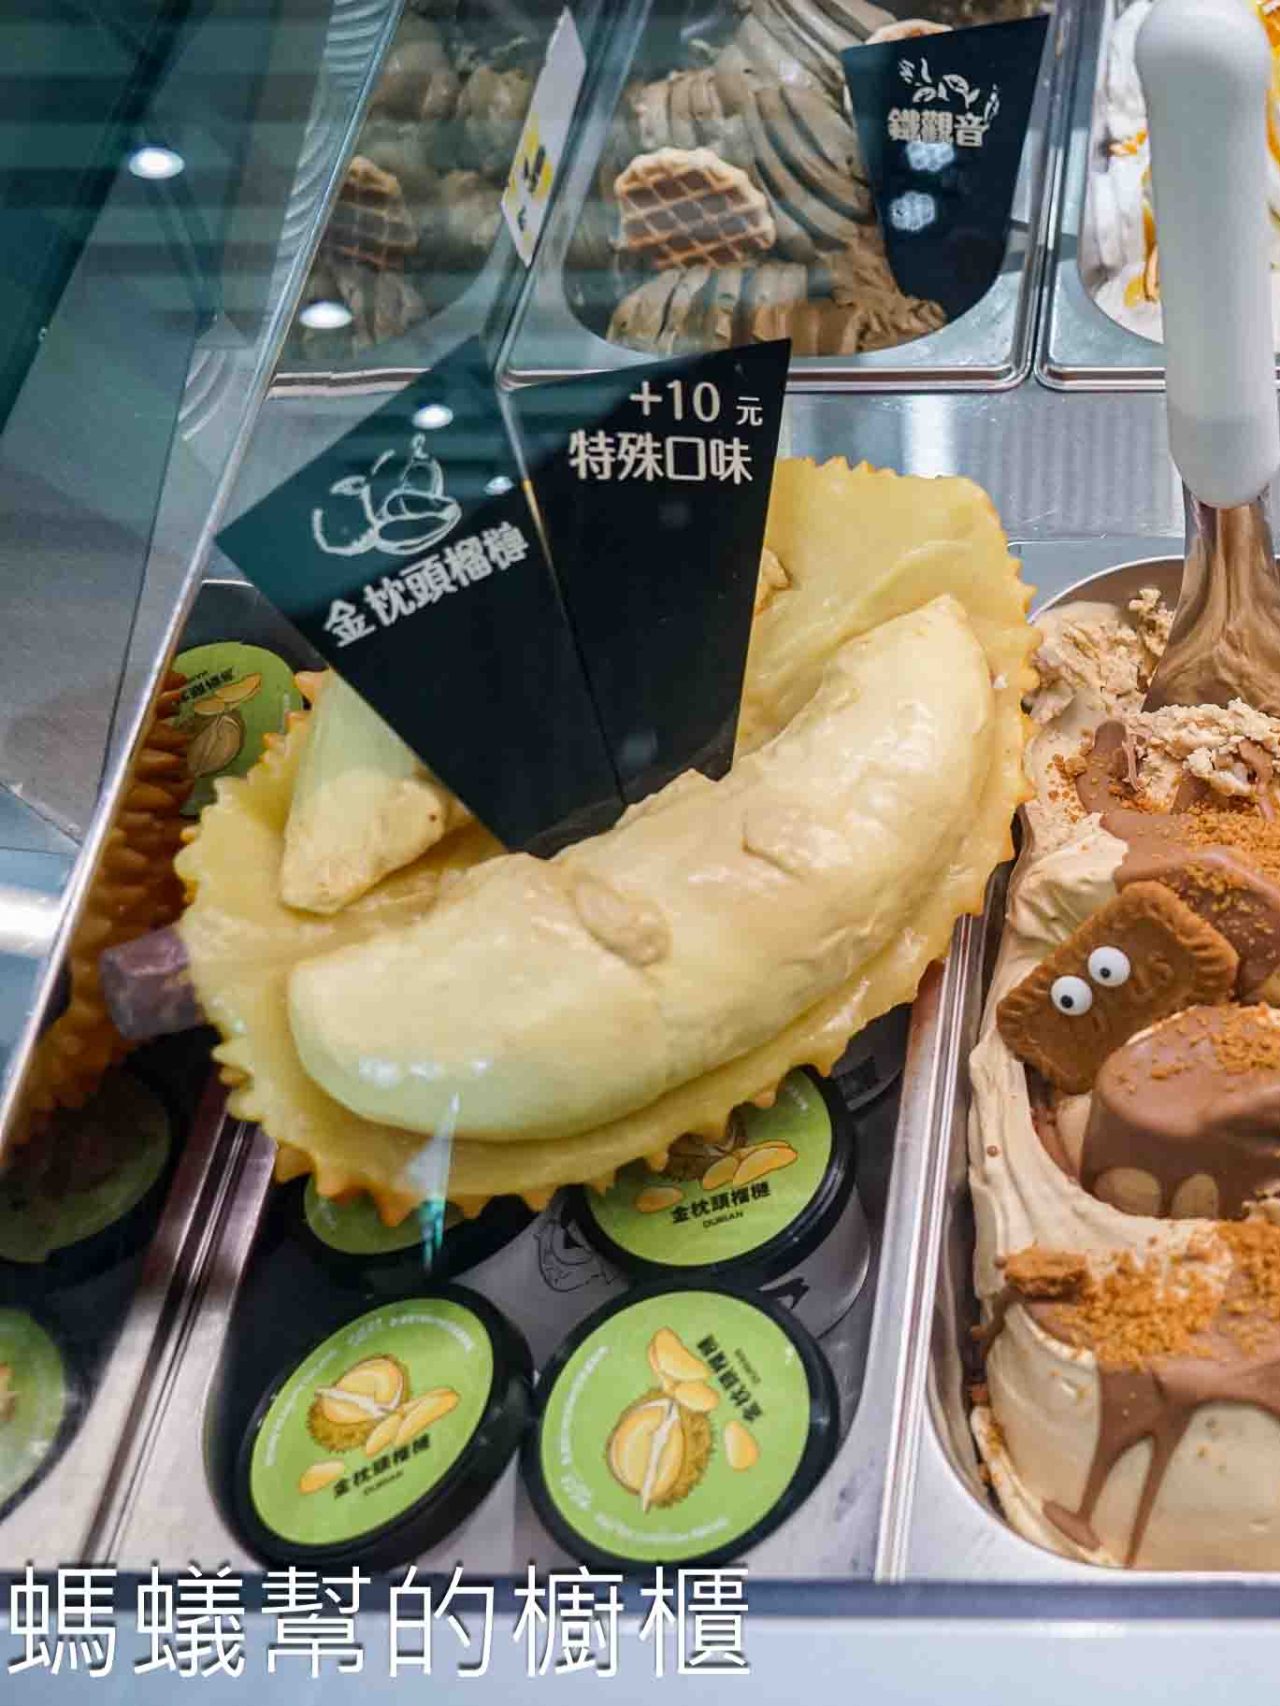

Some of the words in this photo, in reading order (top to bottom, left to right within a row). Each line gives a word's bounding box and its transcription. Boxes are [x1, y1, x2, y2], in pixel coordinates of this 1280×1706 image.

[629, 379, 721, 422] +10
[735, 396, 763, 426] 元
[569, 429, 754, 485] 特殊口味
